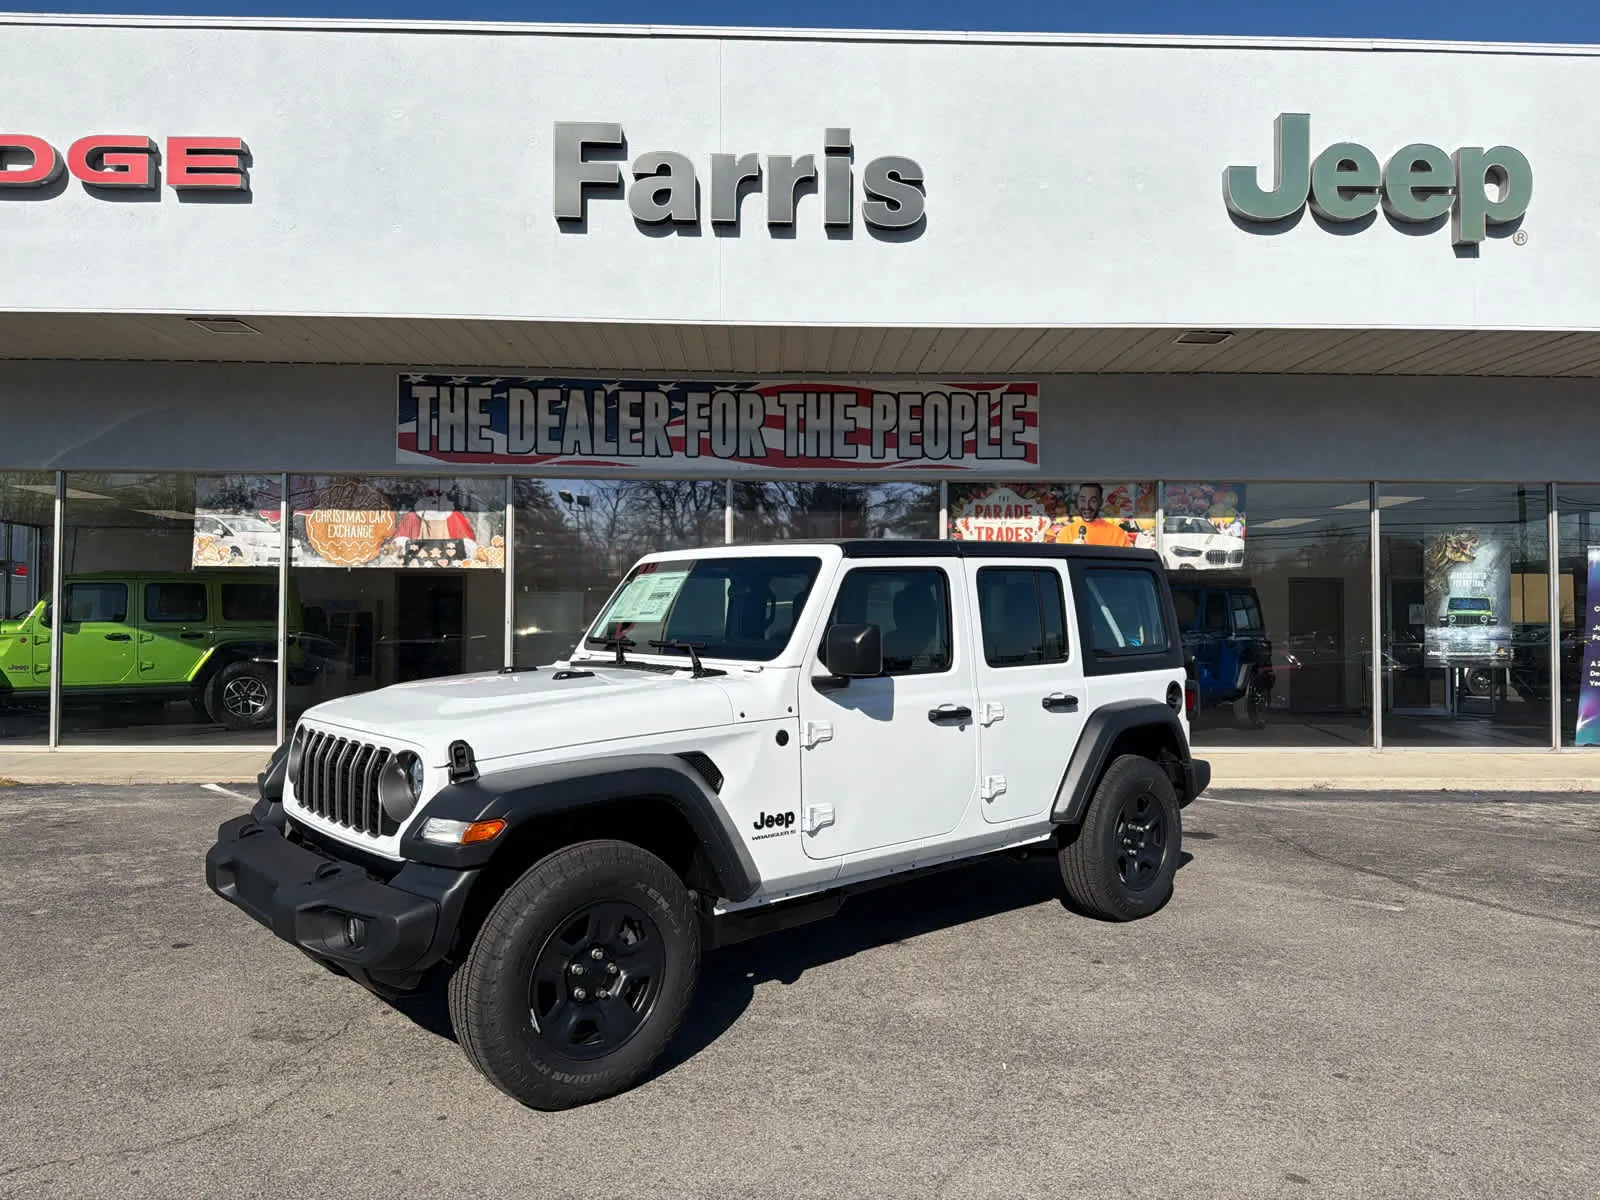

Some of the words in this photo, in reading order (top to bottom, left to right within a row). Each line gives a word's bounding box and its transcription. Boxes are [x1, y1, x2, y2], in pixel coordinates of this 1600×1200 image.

[552, 121, 927, 231] Farris
[1222, 112, 1533, 243] Jeep
[410, 385, 495, 454] THE
[506, 386, 674, 458] DEALER
[684, 389, 768, 459] FOR
[777, 391, 858, 459] THE
[870, 390, 1028, 461] PEOPLE
[315, 509, 366, 523] CHRISTMAS
[369, 509, 387, 524] CAR
[974, 503, 1033, 519] PARADE
[327, 524, 374, 537] EXCHANGE
[974, 526, 1033, 542] TRADES
[753, 811, 795, 830] Jeep
